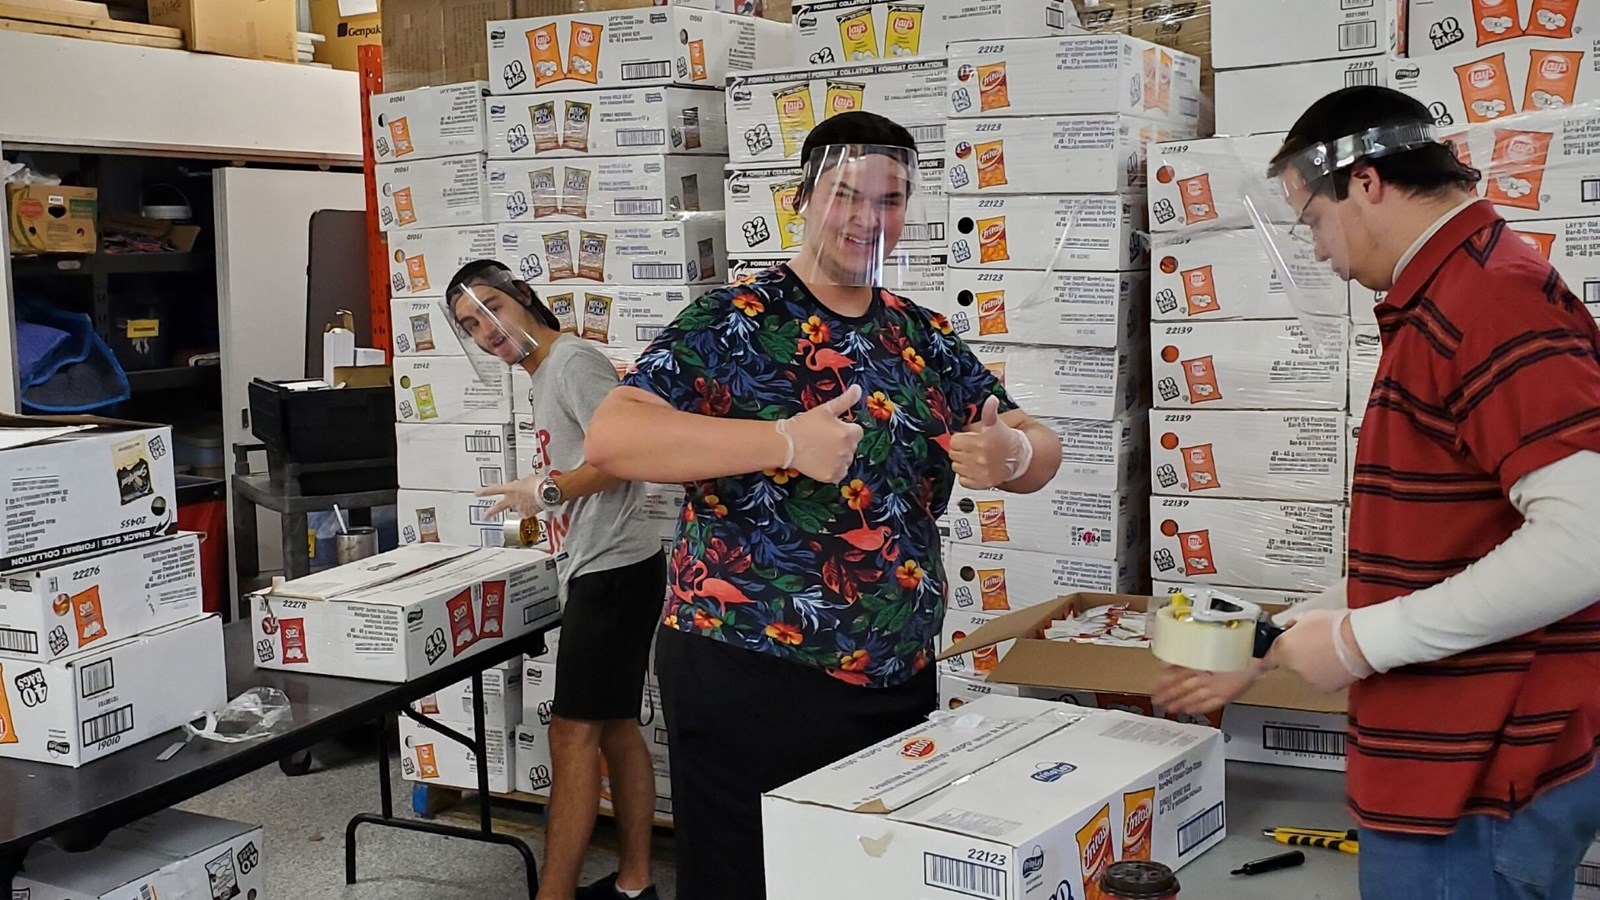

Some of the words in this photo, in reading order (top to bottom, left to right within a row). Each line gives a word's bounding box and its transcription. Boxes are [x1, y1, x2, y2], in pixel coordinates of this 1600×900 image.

[846, 22, 867, 37] Lay's
[894, 17, 914, 29] Lay's
[1429, 17, 1459, 38] 40
[348, 24, 382, 38] Genpak
[1433, 30, 1464, 50] BAGS
[977, 44, 1004, 54] 22123
[503, 60, 524, 79] 40
[878, 63, 906, 72] FORMAT
[907, 61, 945, 71] COLLATION
[1347, 61, 1374, 69] 22139
[1541, 57, 1568, 73] Lay's
[506, 72, 526, 89] BAGS
[1470, 69, 1495, 84] Lay's
[783, 99, 805, 114] Lay's
[832, 96, 855, 112] Lay's
[507, 124, 526, 142] 40
[744, 124, 768, 145] 32
[975, 123, 1002, 132] 22123
[510, 137, 529, 152] SACS
[749, 137, 773, 155] SACS
[745, 169, 772, 177] FORMAT
[507, 190, 526, 209] 40
[977, 199, 1004, 208] 22123
[1153, 198, 1171, 212] 40
[509, 203, 528, 219] SACS
[742, 215, 766, 237] 32
[746, 230, 770, 247] SACS
[520, 253, 540, 273] 40
[750, 259, 774, 268] FORMAT
[523, 265, 543, 281] SACS
[977, 273, 1004, 282] 22123
[1165, 326, 1193, 335] 22139
[1157, 376, 1174, 391] 40
[1164, 414, 1192, 422] 22139
[1156, 464, 1172, 476] 40
[1162, 499, 1190, 507] 22139
[119, 516, 147, 529] 20455
[101, 535, 122, 547] SIZE
[122, 529, 151, 543] SNACK
[63, 541, 96, 555] FORMAT
[1153, 548, 1169, 561] 40
[10, 550, 61, 567] COLLATION
[978, 552, 1004, 560] 22123
[72, 565, 101, 581] 22276
[282, 600, 307, 610] 22278
[49, 625, 63, 641] 40
[425, 628, 446, 649] 40
[256, 639, 271, 652] 40
[427, 643, 447, 666] SACS
[16, 669, 45, 691] BAGS
[20, 682, 48, 708] 40
[967, 684, 992, 693] 22123
[537, 700, 553, 715] 40
[97, 735, 121, 752] 01061
[529, 764, 549, 780] 40
[532, 777, 550, 790] SACS
[1127, 806, 1149, 835] Fritos
[1084, 824, 1107, 869] Fritos
[968, 848, 1007, 867] 22123
